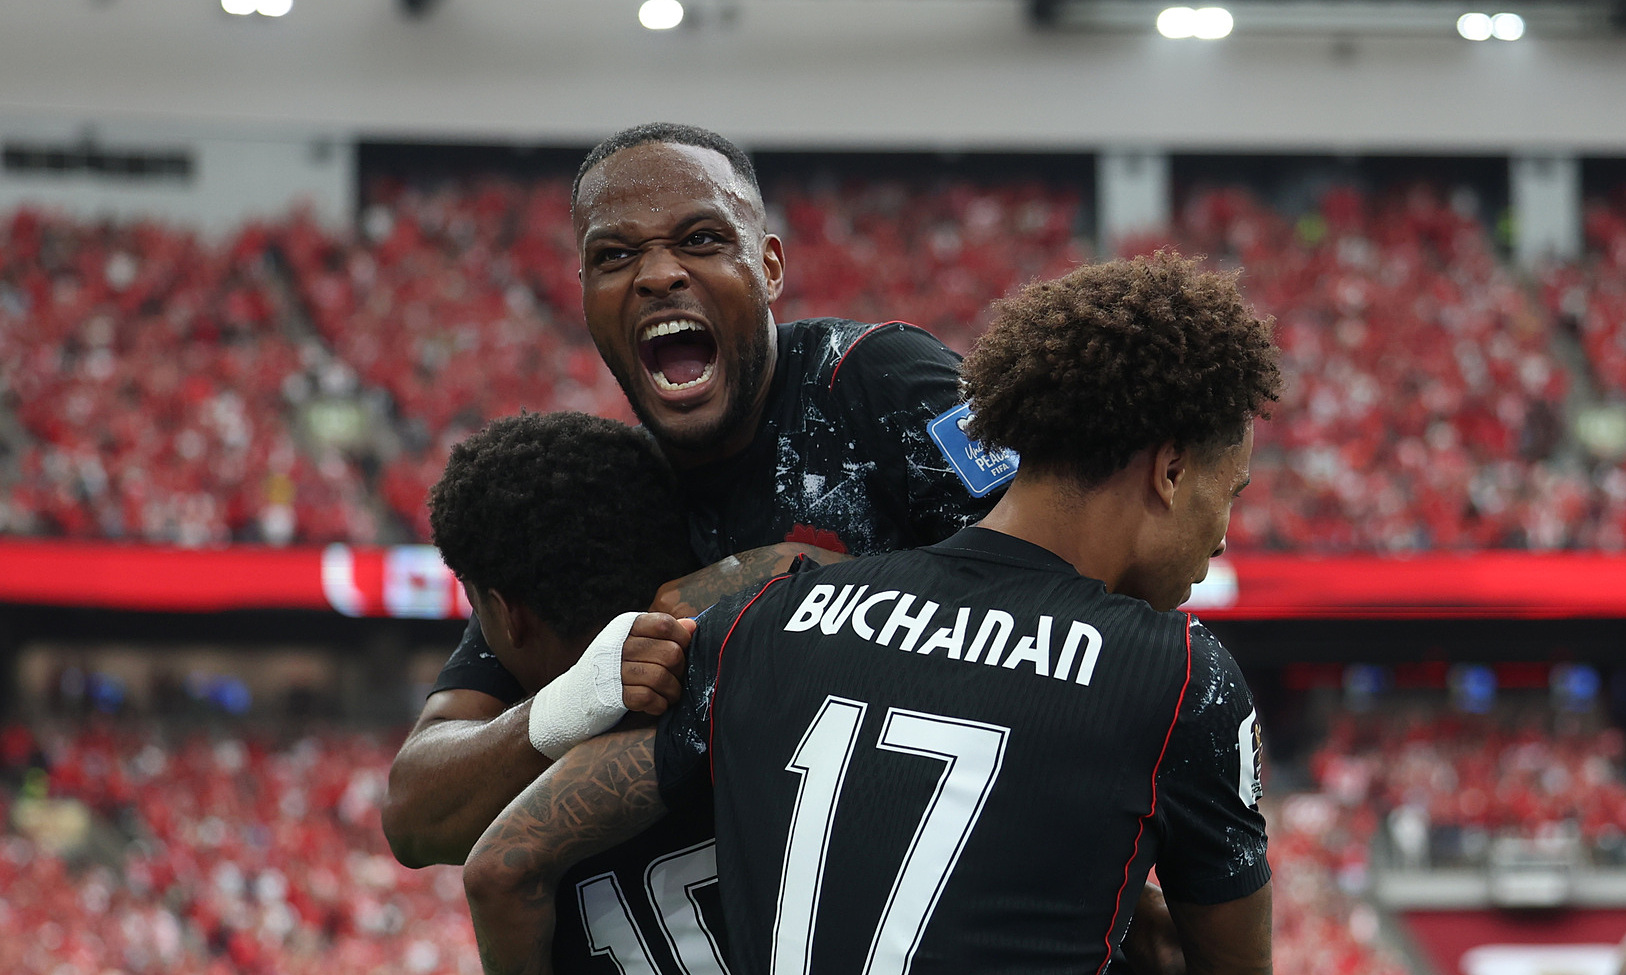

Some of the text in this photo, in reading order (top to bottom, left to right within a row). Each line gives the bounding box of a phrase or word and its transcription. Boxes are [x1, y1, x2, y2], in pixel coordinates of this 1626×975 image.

[990, 463, 1010, 477] FIFA
[783, 583, 1103, 686] BUCHANAN
[769, 694, 1011, 975] 17
